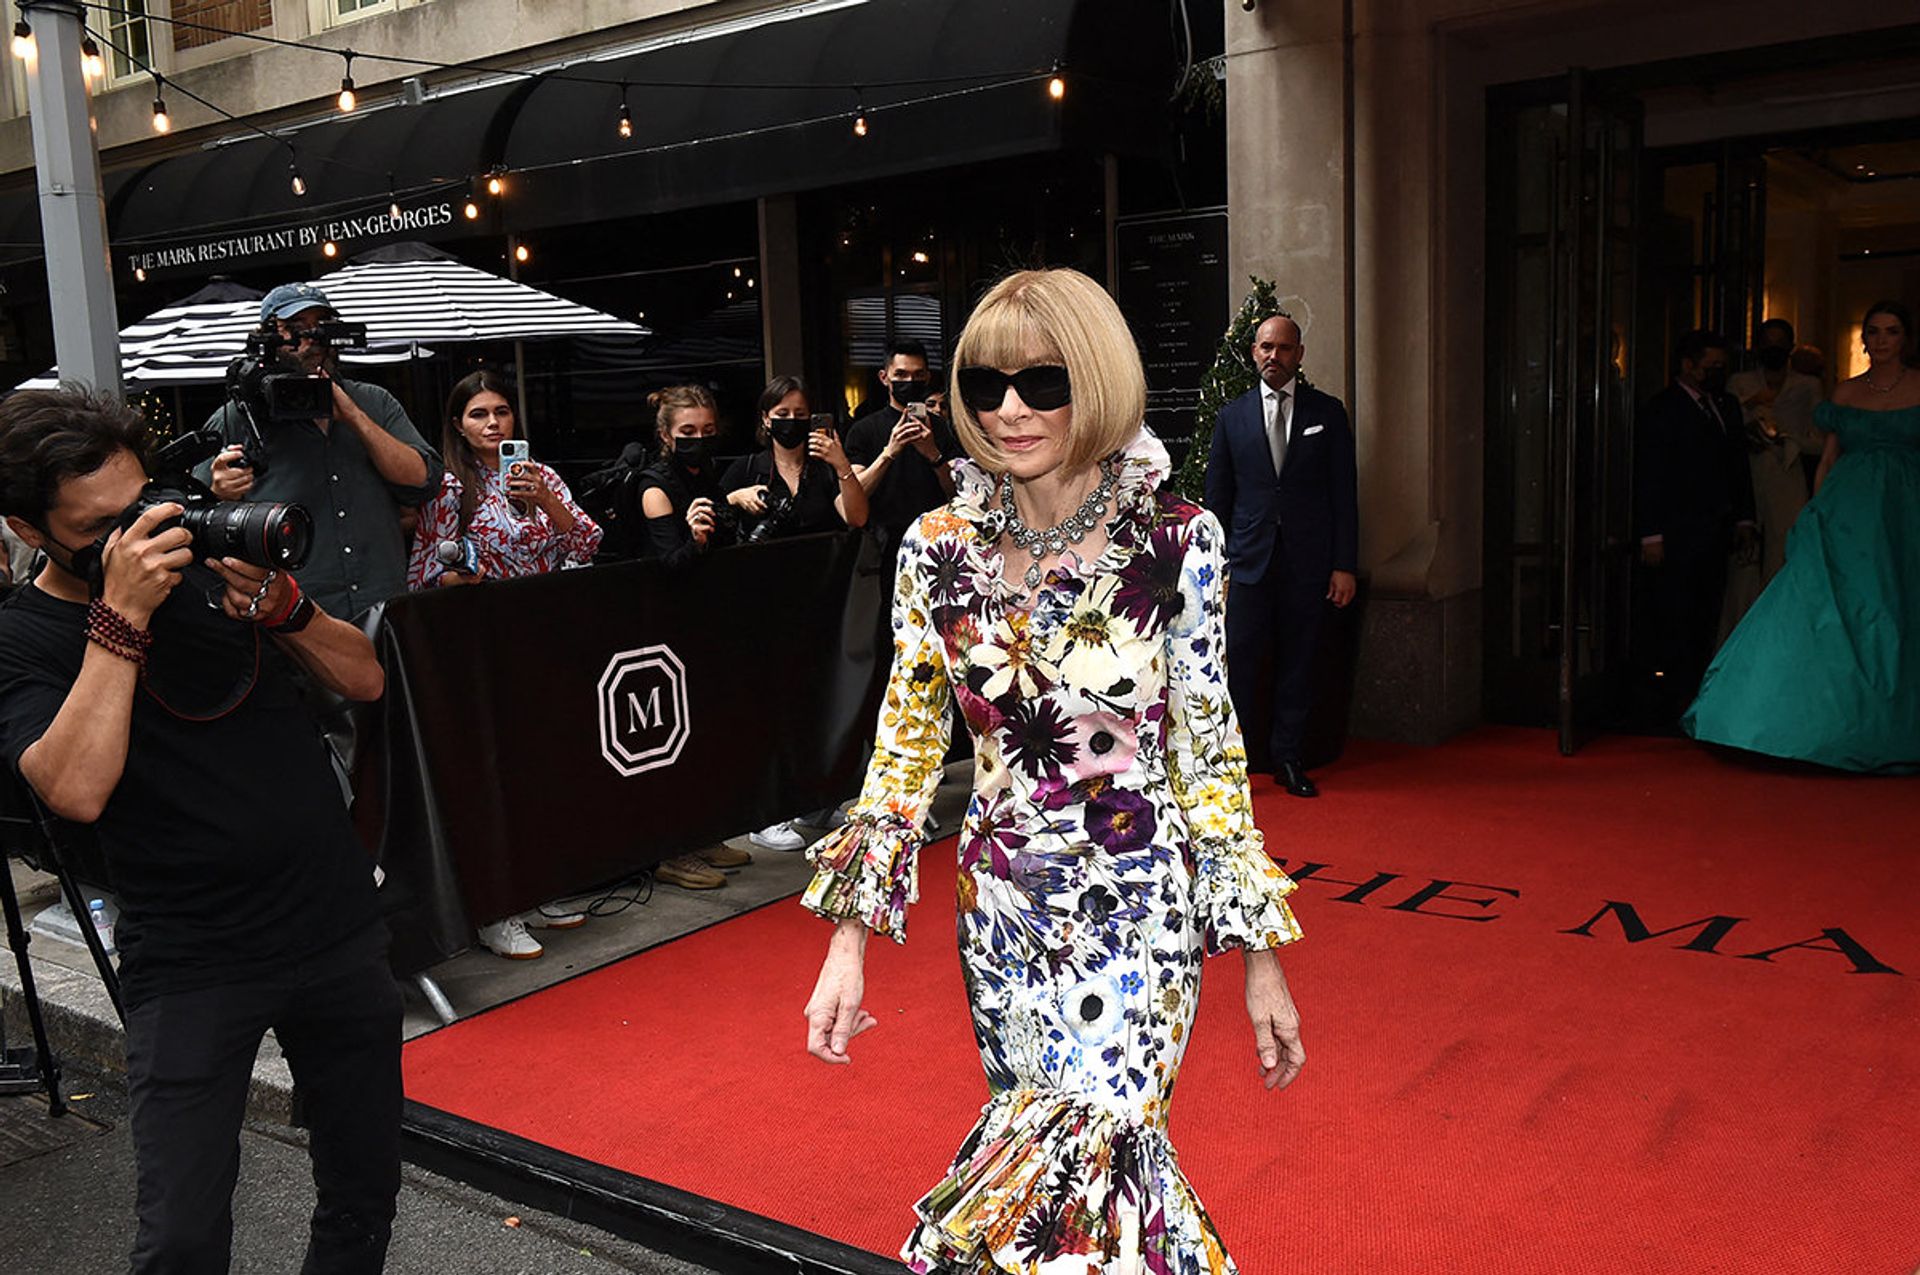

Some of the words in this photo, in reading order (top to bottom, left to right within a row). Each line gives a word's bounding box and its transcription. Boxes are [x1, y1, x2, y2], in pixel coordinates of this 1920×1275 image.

[157, 246, 197, 267] MARK
[198, 229, 296, 261] RESTAURANT
[299, 225, 320, 246] BY
[322, 203, 453, 243] JEAN-GEORGES
[627, 686, 664, 734] M
[1271, 856, 1520, 922] HE
